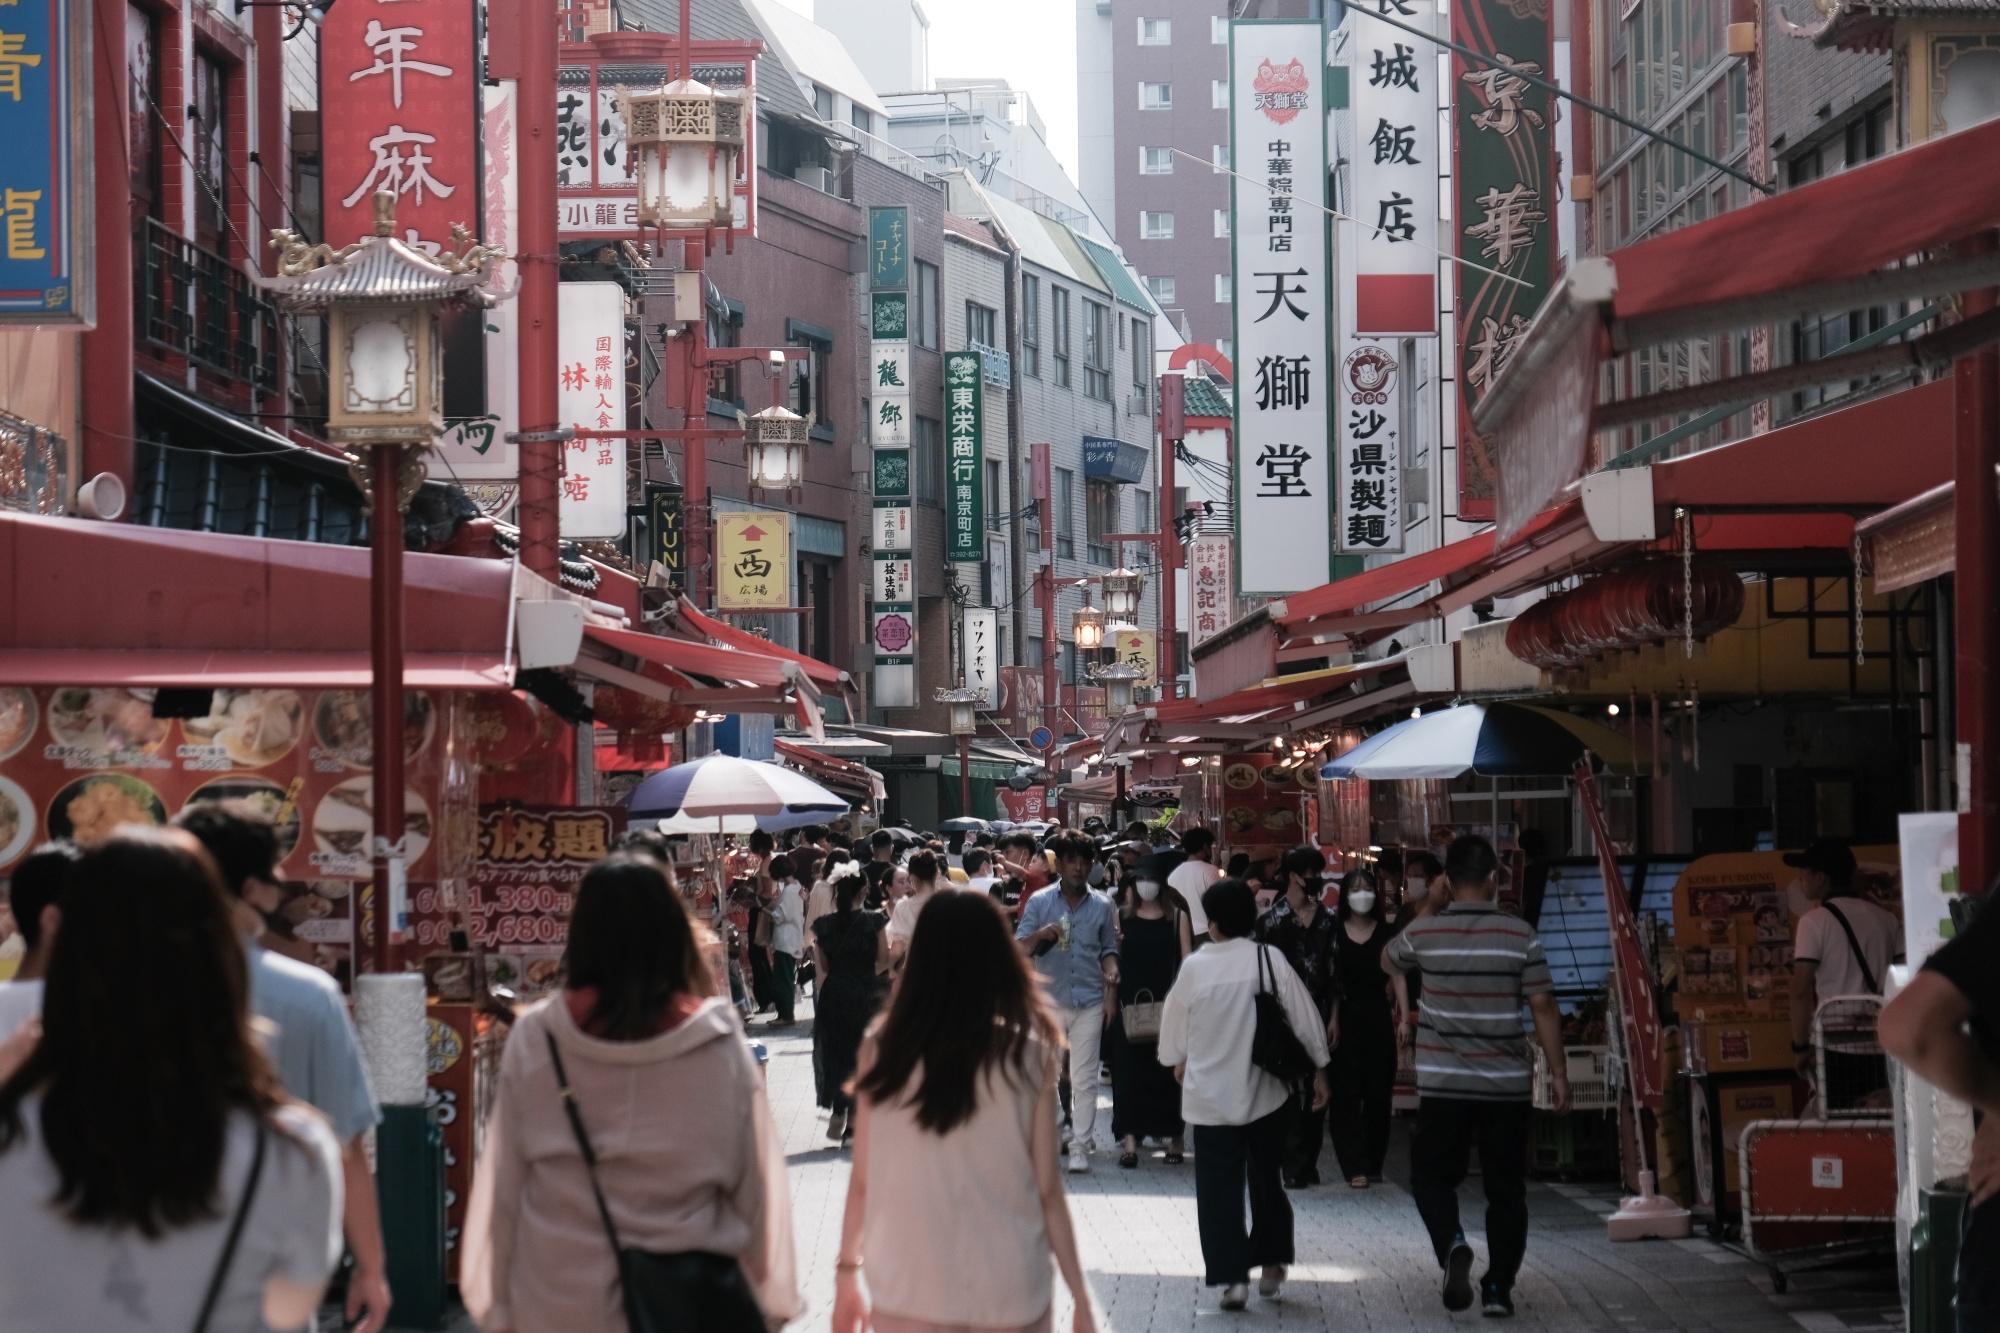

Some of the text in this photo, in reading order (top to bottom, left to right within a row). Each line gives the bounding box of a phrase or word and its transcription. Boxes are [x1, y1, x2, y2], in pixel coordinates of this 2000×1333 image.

[343, 0, 455, 257] 年麻
[558, 203, 637, 225] 小籠包
[876, 239, 887, 273] コート
[890, 220, 902, 266] チャイナ
[1253, 267, 1312, 498] 天獅堂
[951, 386, 975, 547] 東栄商行 南京町店
[663, 511, 678, 568] YUN
[884, 510, 895, 548] 三木商店
[733, 549, 772, 578] 西
[739, 584, 768, 596] 広場
[478, 818, 607, 859] 放題
[1688, 872, 1775, 885] KOBE PUDDING
